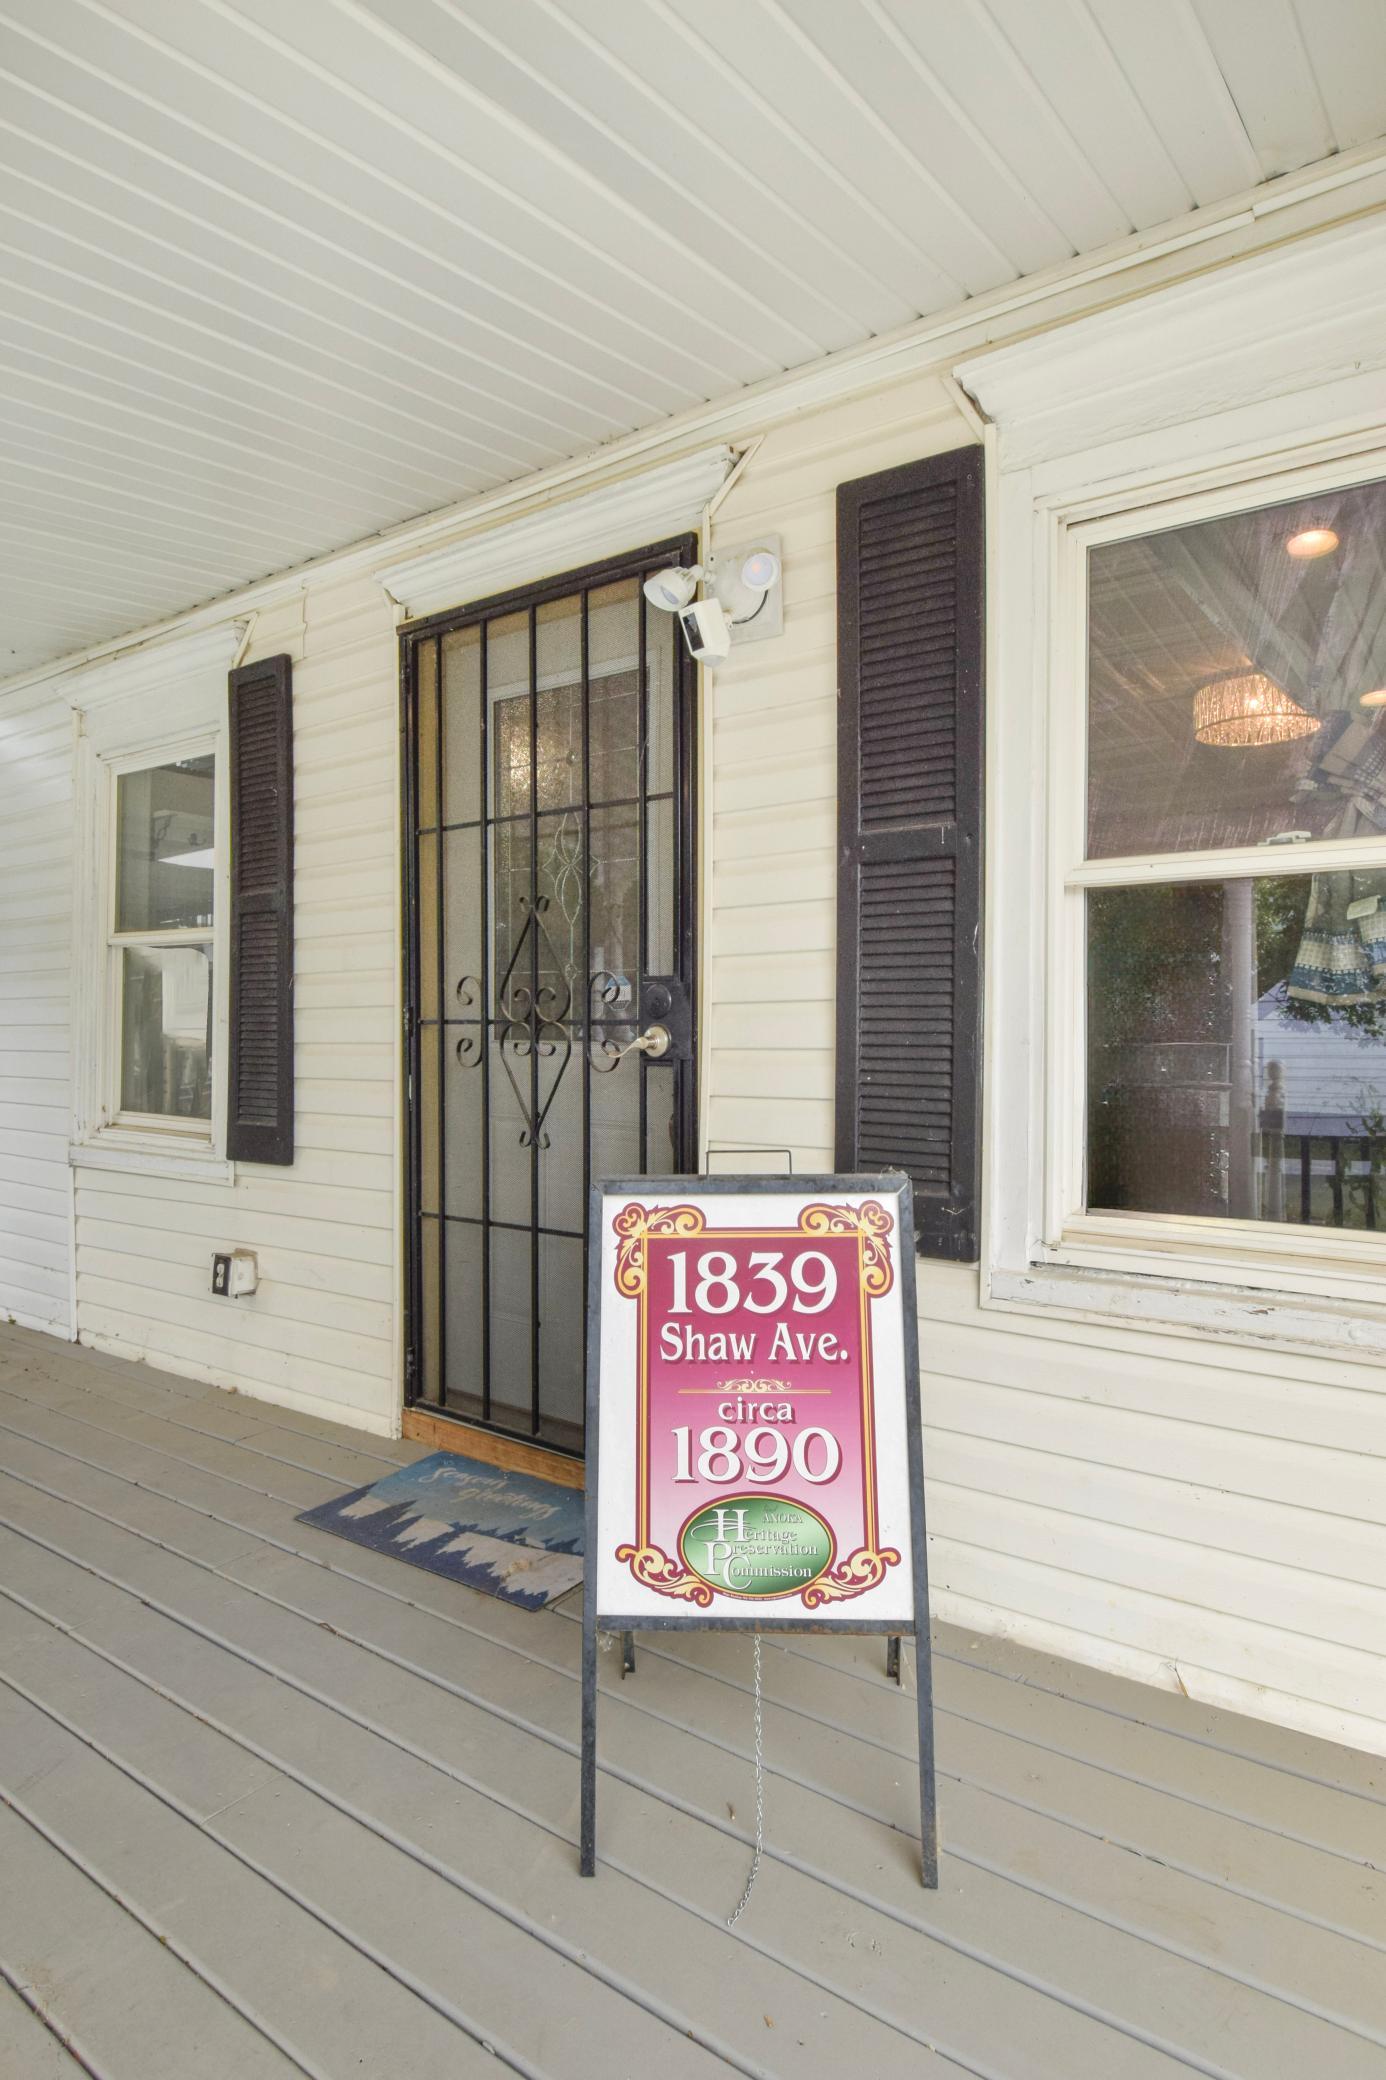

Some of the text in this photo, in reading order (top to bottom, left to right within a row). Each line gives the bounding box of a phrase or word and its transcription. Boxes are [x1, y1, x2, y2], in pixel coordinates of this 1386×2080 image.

[667, 1251, 838, 1314] 1839
[660, 1322, 848, 1361] Shaw Ave.
[718, 1396, 793, 1421] circa
[671, 1426, 840, 1482] 1890
[710, 1509, 799, 1544] Heritage
[704, 1542, 819, 1575] Preservation
[723, 1556, 813, 1590] Commission
